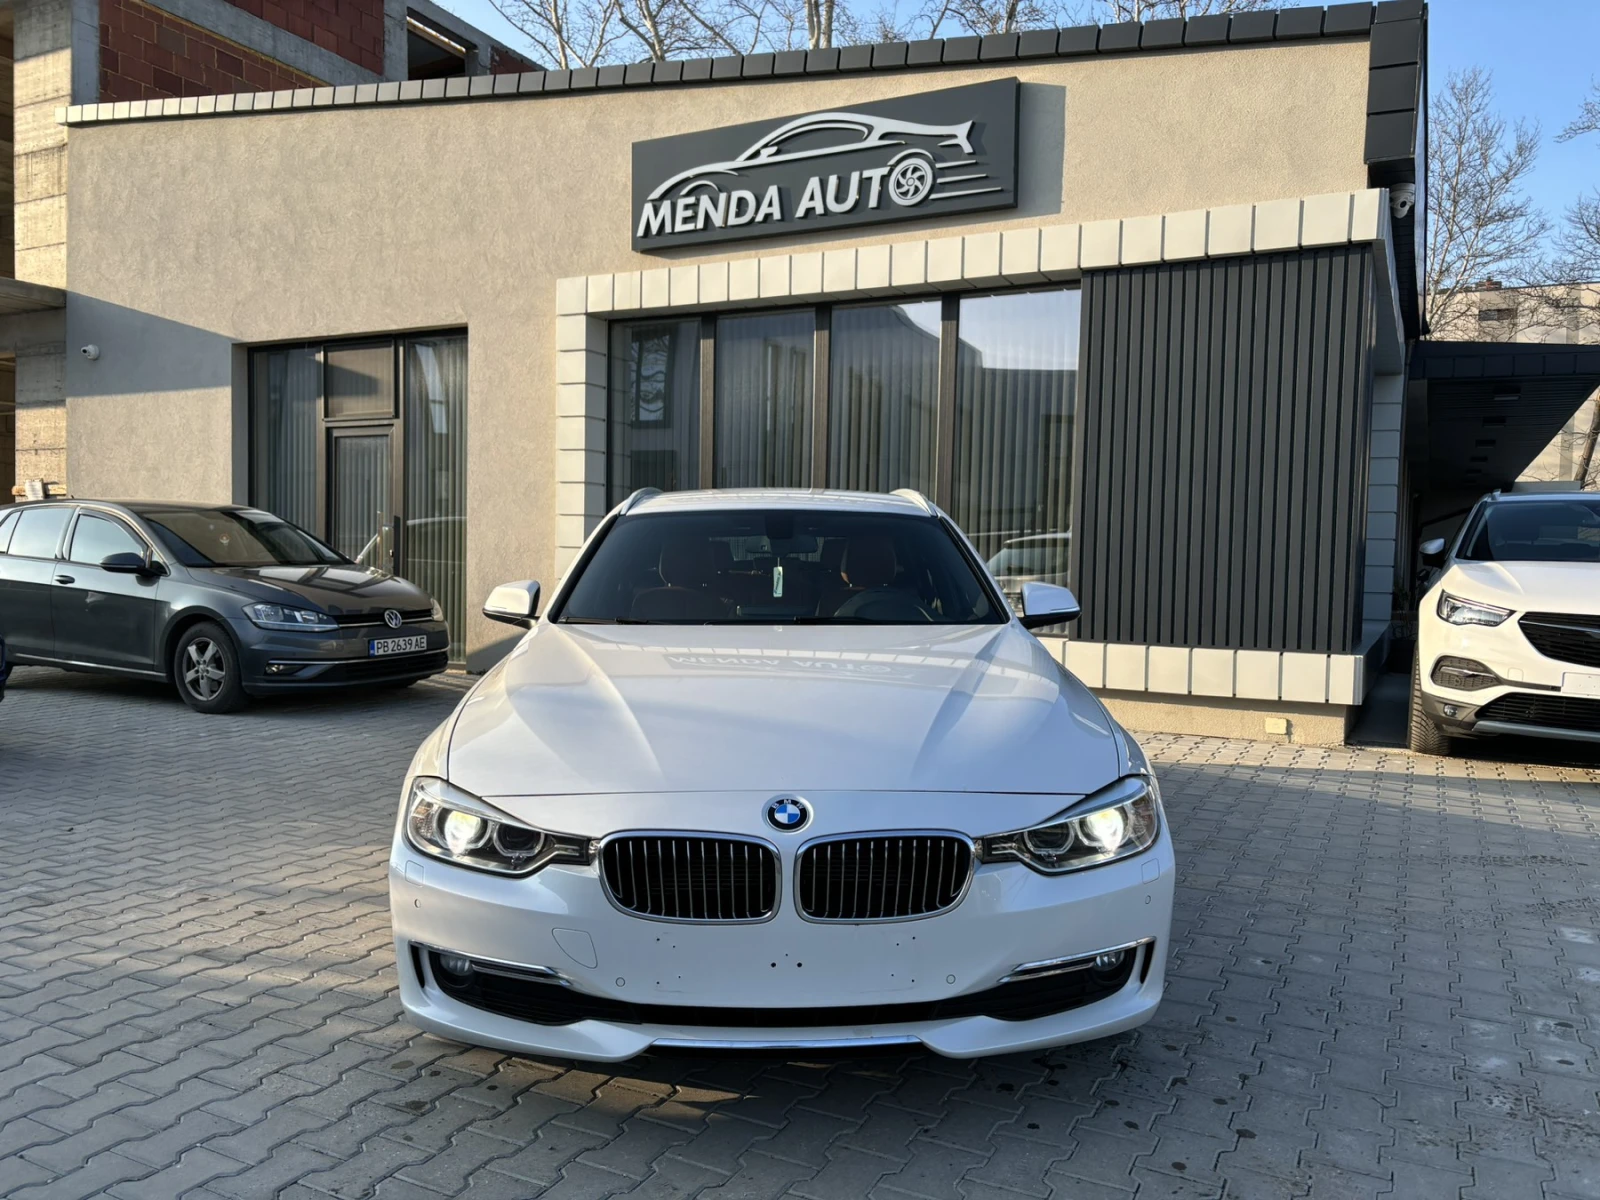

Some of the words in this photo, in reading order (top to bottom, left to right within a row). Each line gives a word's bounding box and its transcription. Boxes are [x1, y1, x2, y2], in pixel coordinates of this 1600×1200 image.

[636, 185, 782, 237] MENDA
[795, 158, 933, 218] AUTO
[376, 640, 389, 653] PB
[391, 638, 413, 652] 2639
[414, 637, 425, 649] AE
[772, 799, 804, 809] BMW
